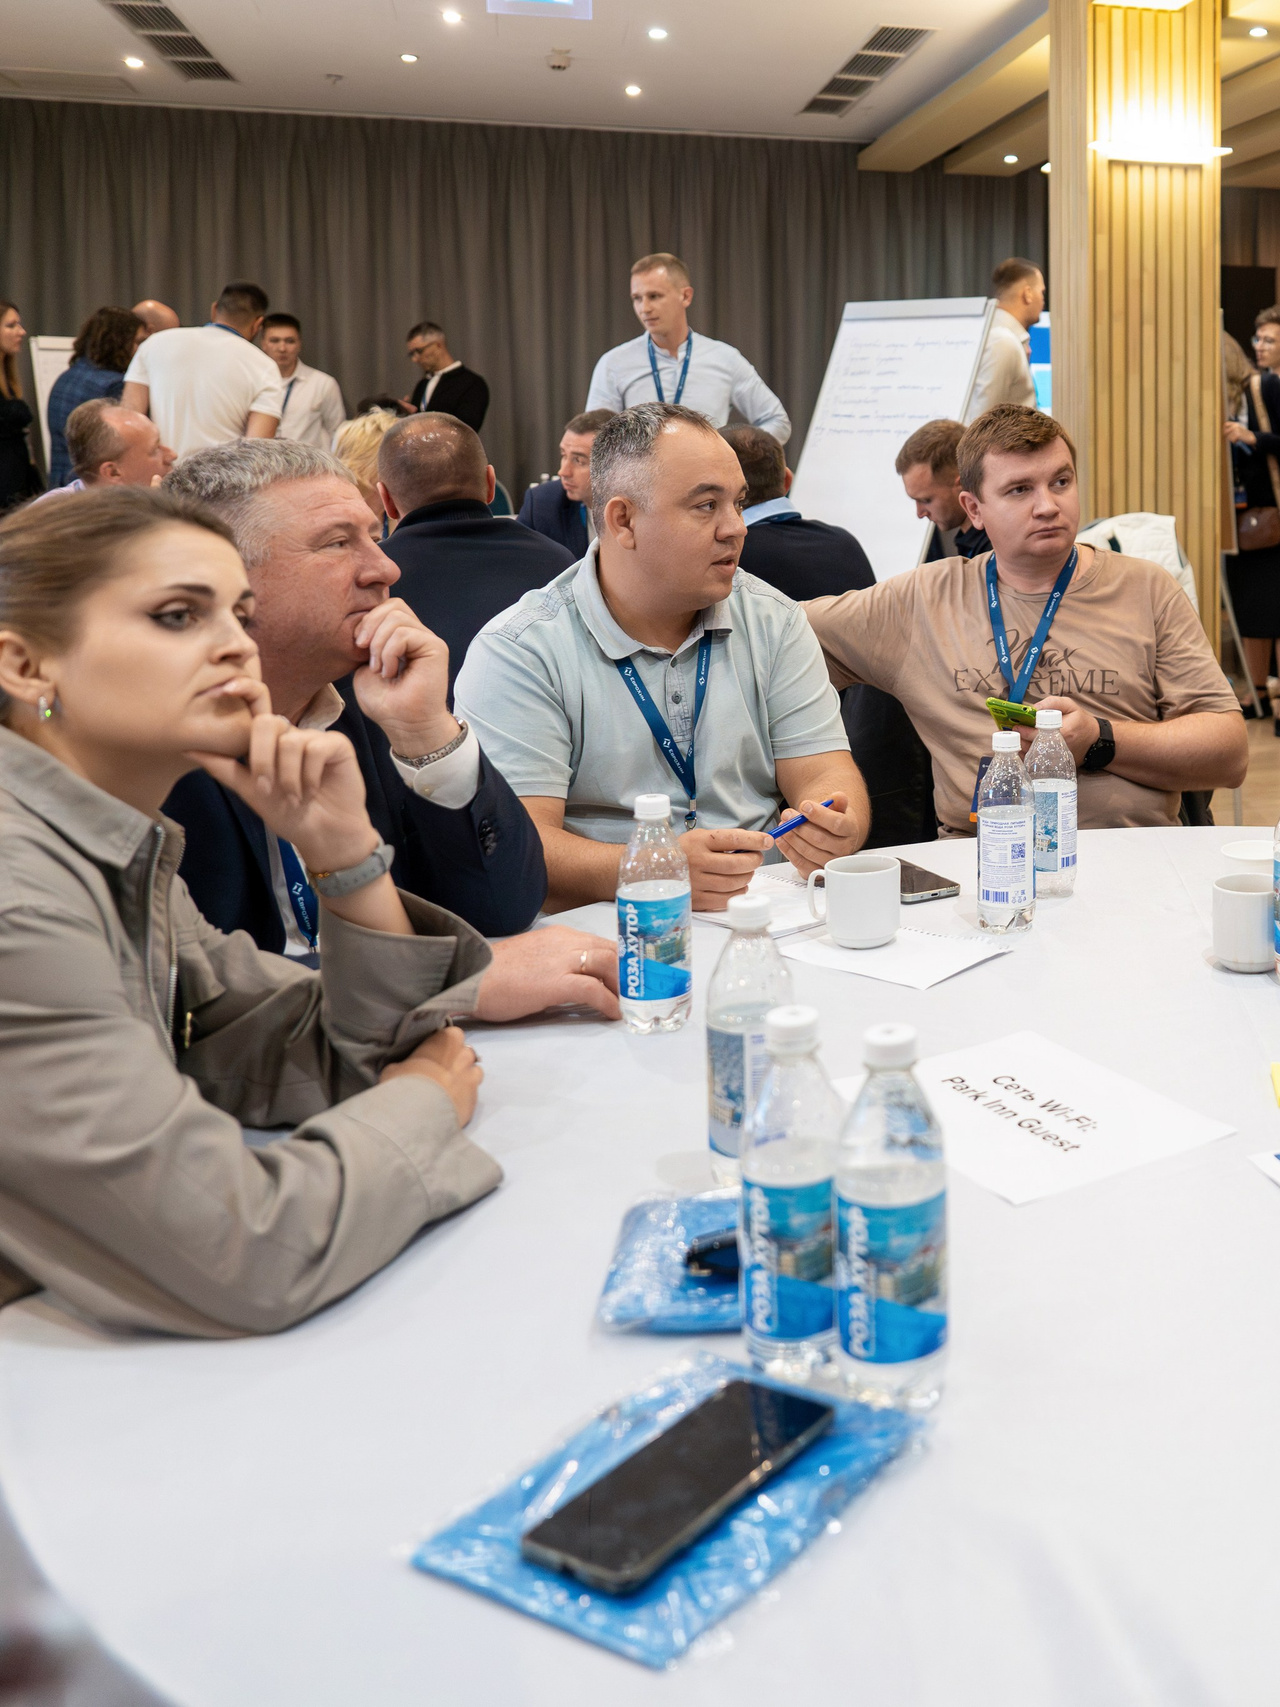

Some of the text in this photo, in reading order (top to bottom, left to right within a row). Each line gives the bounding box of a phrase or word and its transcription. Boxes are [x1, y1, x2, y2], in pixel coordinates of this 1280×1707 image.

[953, 667, 1120, 697] EXREME
[626, 902, 640, 998] РОЗА ХУТОР
[941, 1076, 1082, 1152] Park Inn Guest
[992, 1075, 1098, 1132] Сеть Wi-Fi:
